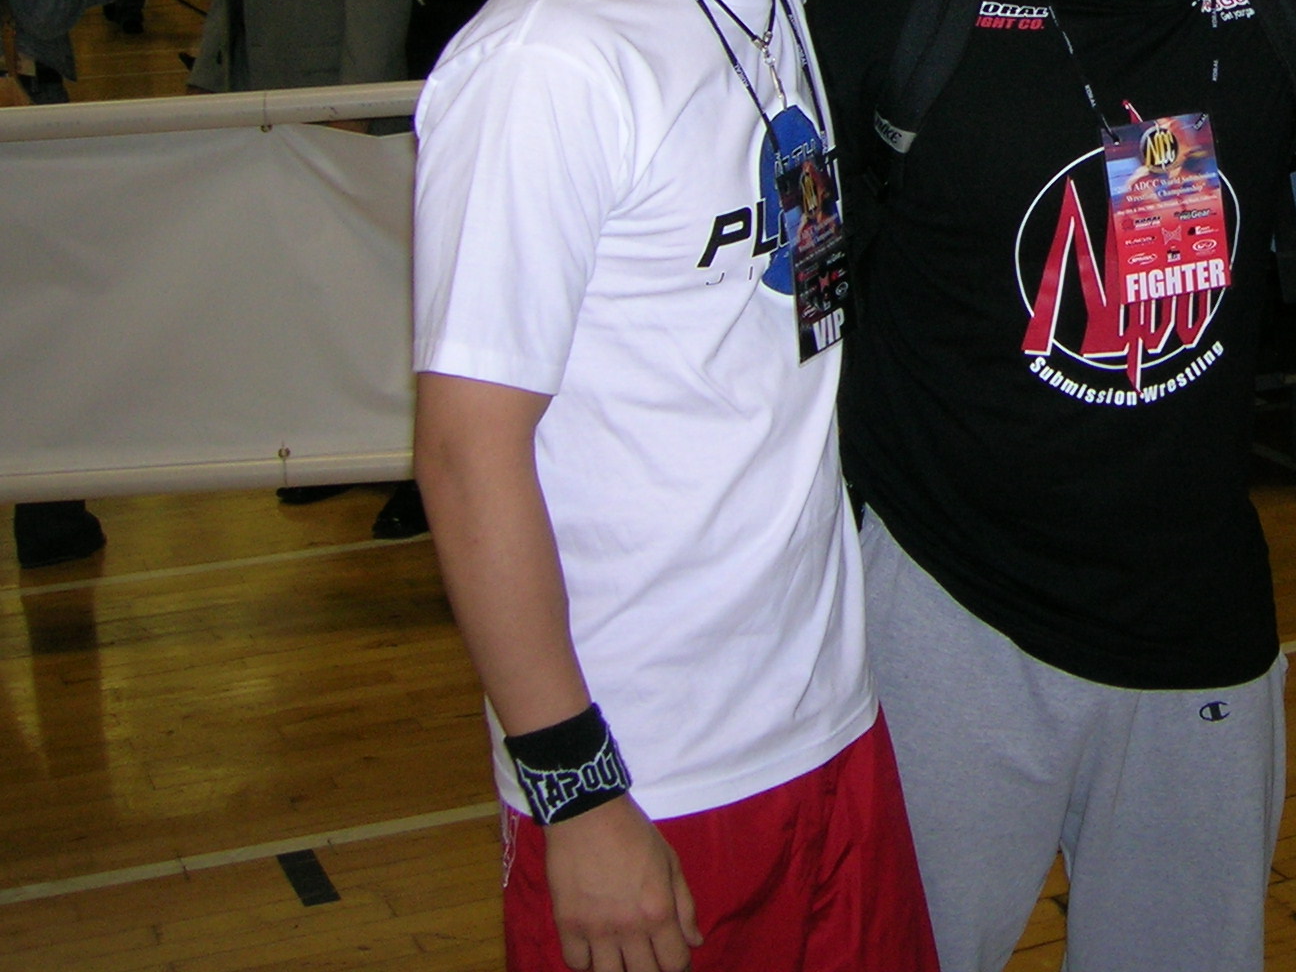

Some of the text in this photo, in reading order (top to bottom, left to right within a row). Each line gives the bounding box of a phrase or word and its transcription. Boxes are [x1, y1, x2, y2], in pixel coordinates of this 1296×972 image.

[975, 16, 1016, 29] IGHT
[980, 0, 1049, 18] ORAL
[1134, 179, 1159, 191] ADCC
[1126, 258, 1226, 303] FIGHTER
[812, 307, 845, 352] VIP
[1029, 340, 1224, 407] Submission Wrestling
